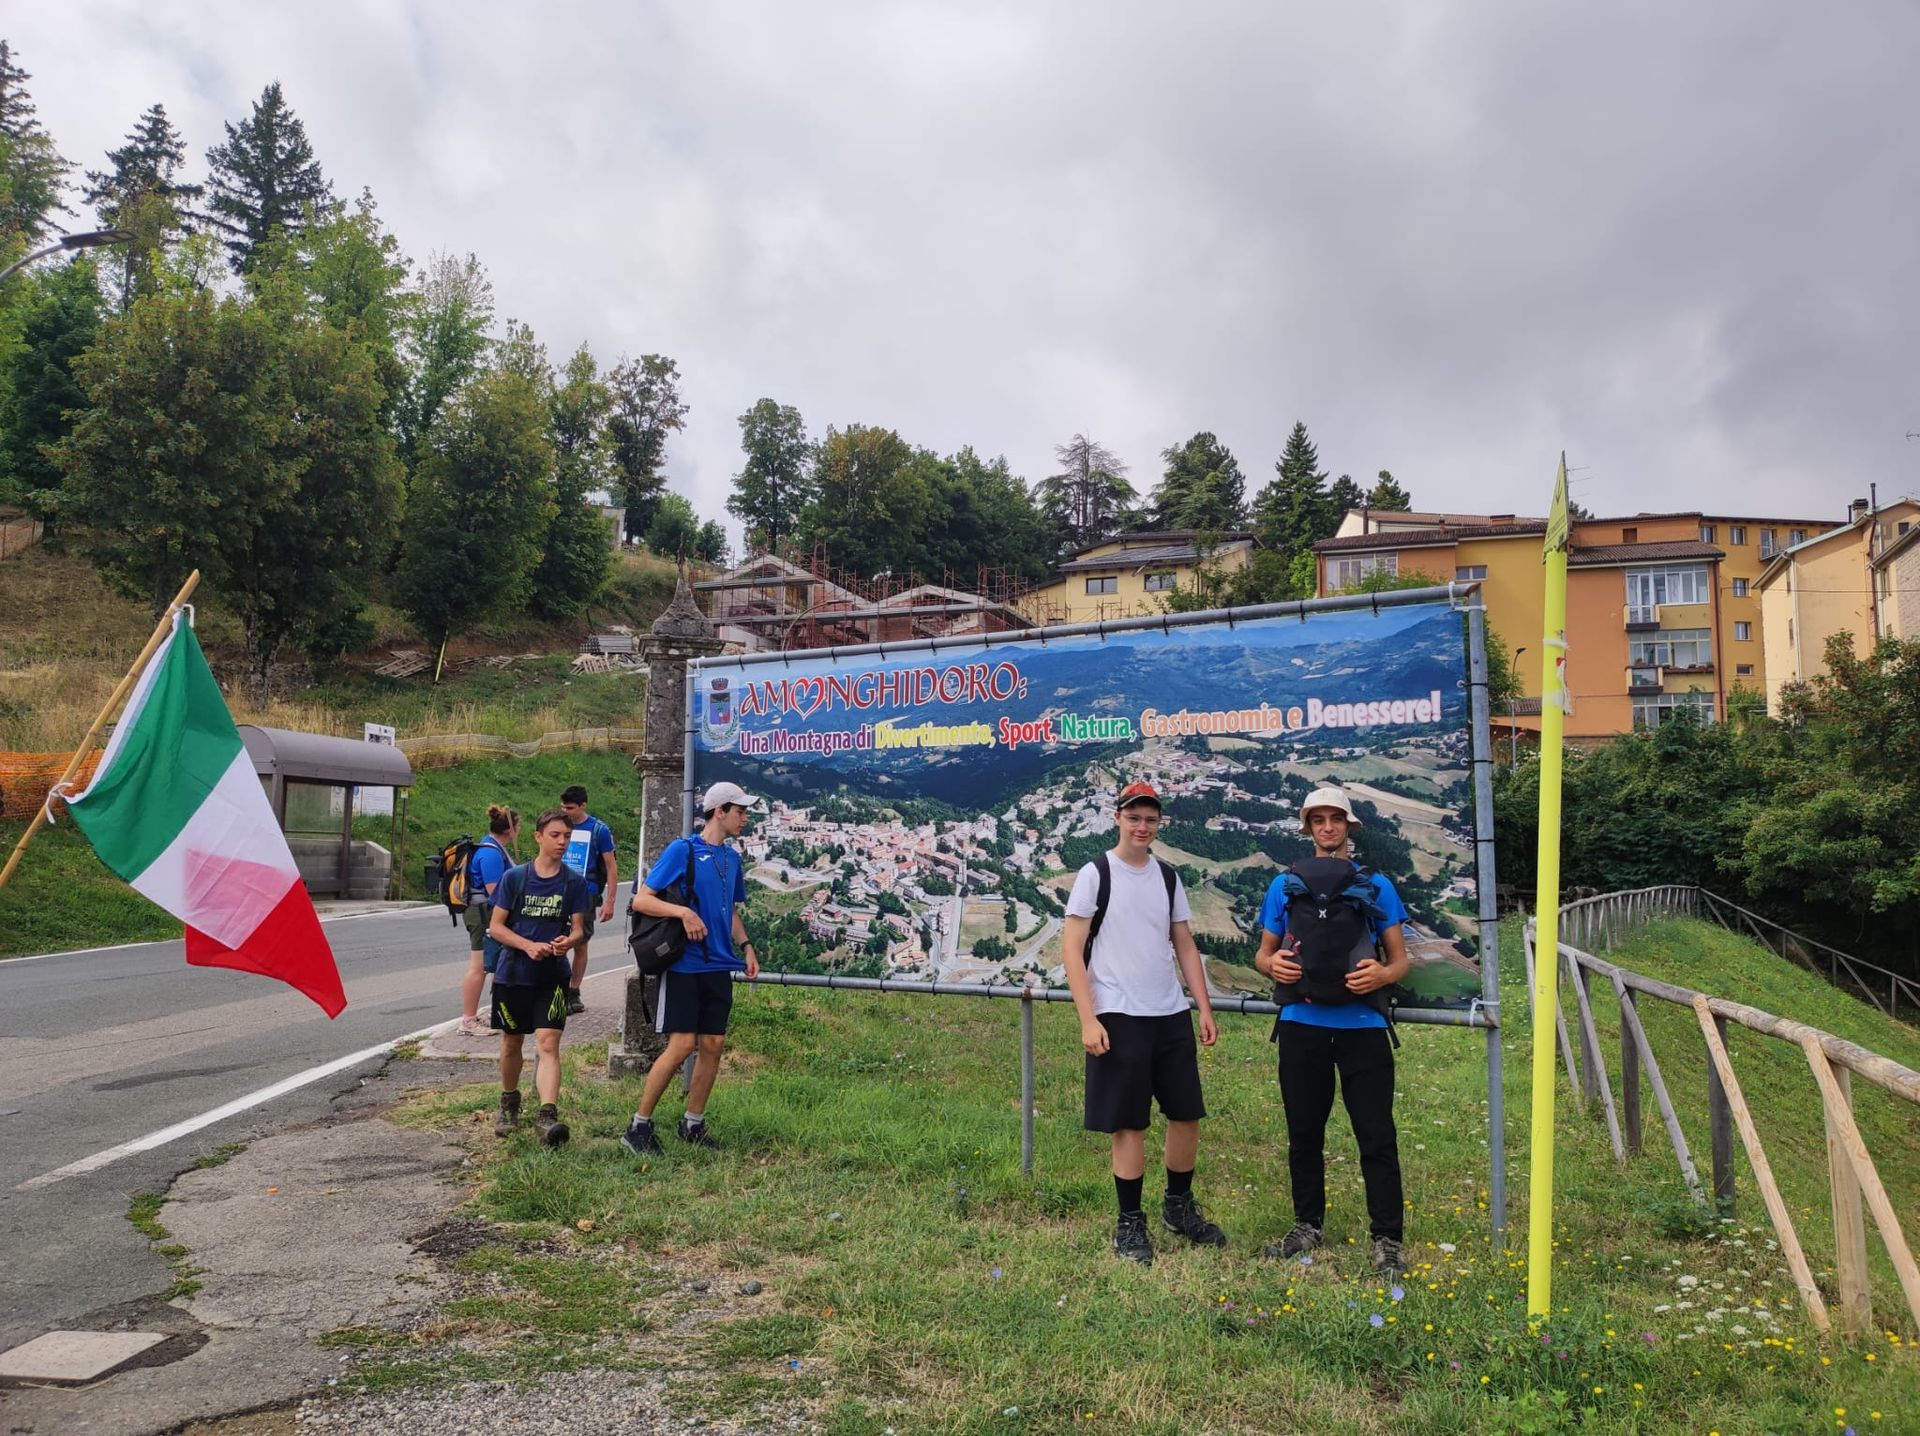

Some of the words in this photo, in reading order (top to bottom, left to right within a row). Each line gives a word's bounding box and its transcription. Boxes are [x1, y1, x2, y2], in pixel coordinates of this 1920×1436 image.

[740, 731, 769, 754] Una
[773, 725, 853, 758] Montagna
[855, 723, 872, 750] di
[875, 721, 995, 748] Divertimento,
[999, 716, 1057, 751] Sport,
[1060, 712, 1137, 743] Natura,
[1140, 701, 1282, 738] Gastronomia
[1288, 706, 1302, 730] e
[1306, 690, 1441, 728] Benessere!
